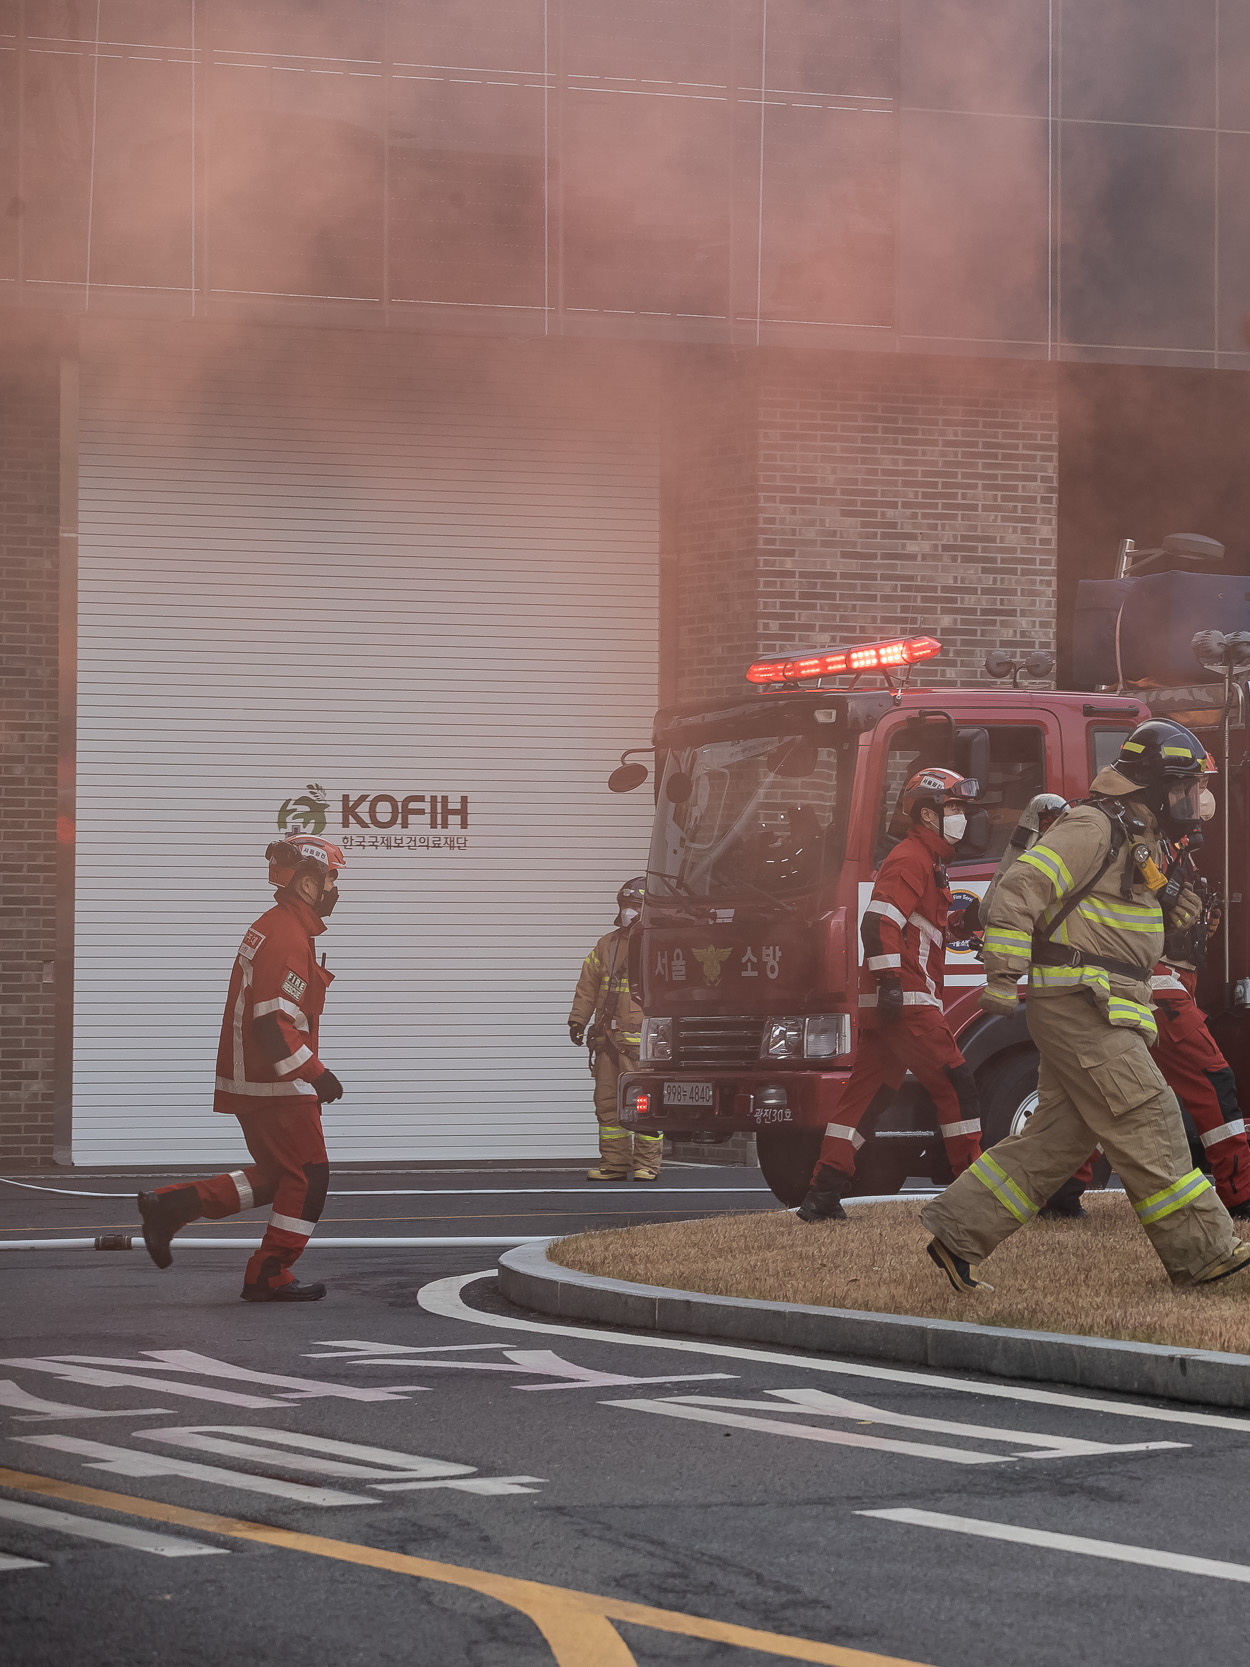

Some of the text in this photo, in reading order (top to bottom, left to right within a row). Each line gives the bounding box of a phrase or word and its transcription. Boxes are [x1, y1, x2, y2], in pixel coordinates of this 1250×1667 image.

[342, 794, 469, 830] KOFIH
[342, 836, 468, 851] 한국국제보건의료재단
[655, 948, 686, 982] 서울
[741, 946, 782, 980] 소방
[287, 972, 306, 990] FIRE
